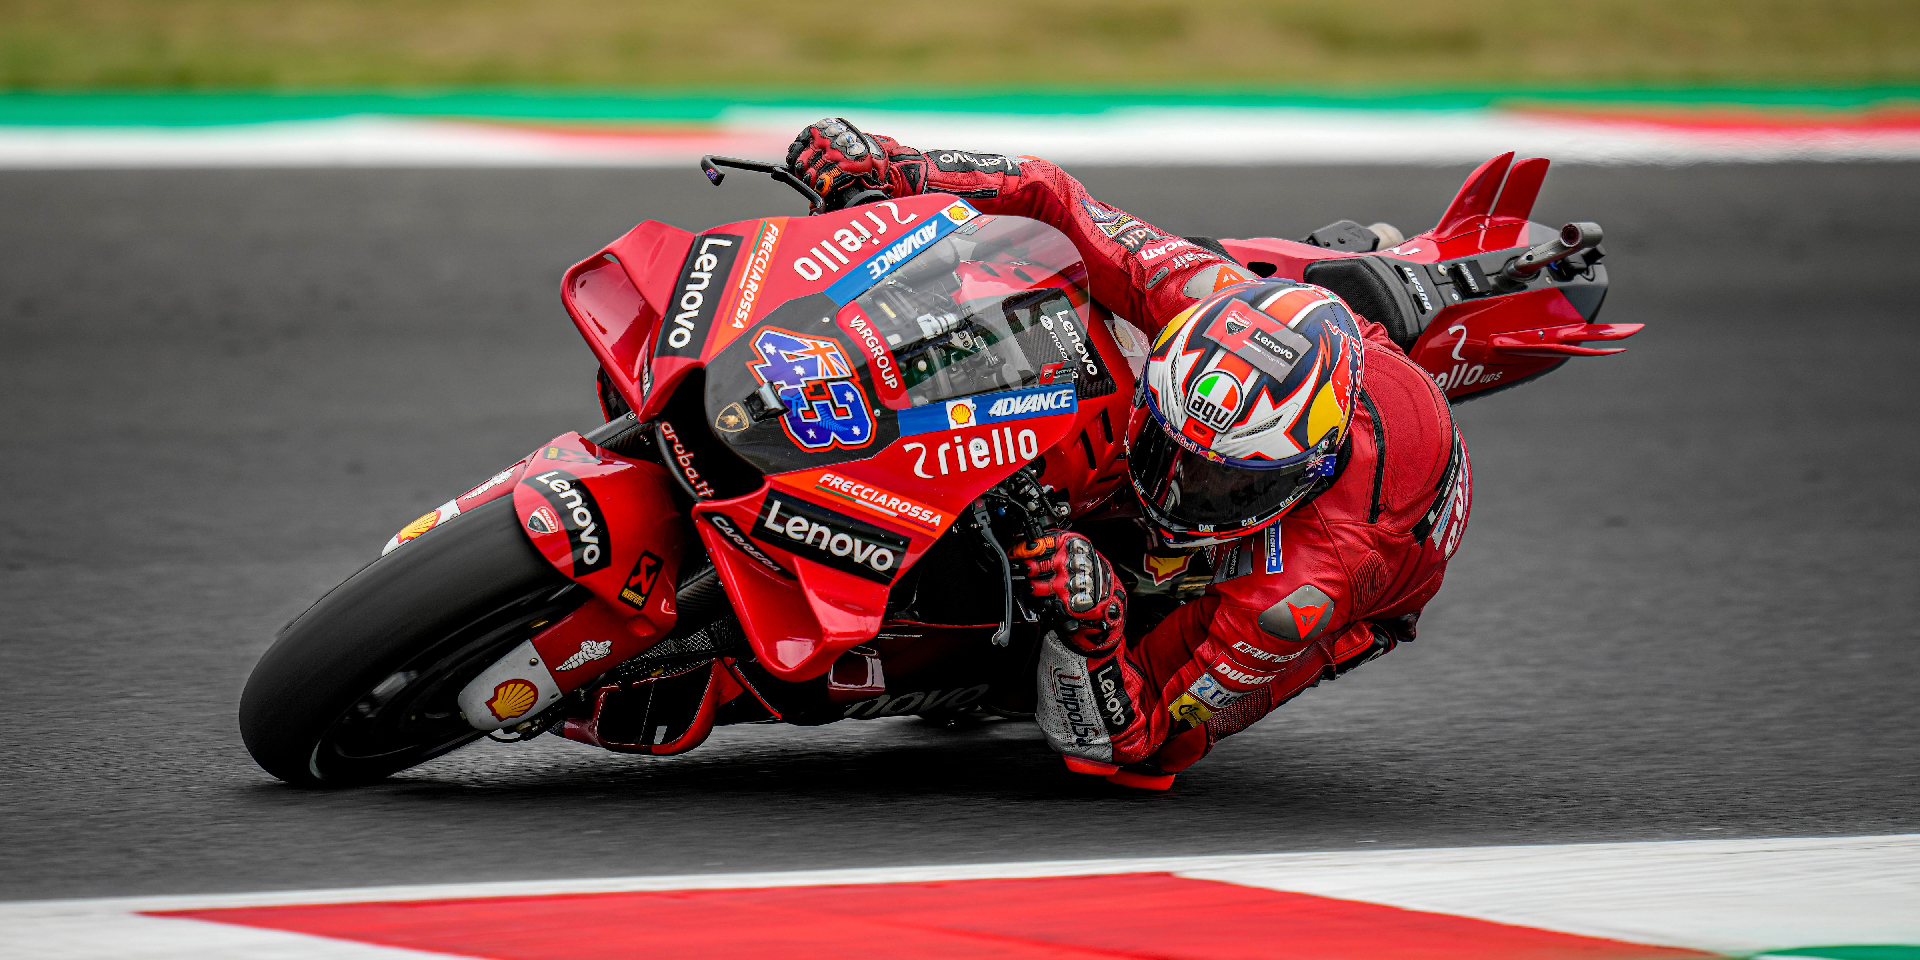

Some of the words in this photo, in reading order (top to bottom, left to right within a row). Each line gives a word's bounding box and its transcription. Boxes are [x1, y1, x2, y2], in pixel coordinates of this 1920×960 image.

[731, 223, 780, 330] FRECCIAROSSA
[866, 219, 939, 280] ADVANCE
[668, 236, 733, 349] Lenovo
[1403, 266, 1433, 311] DUCATI
[848, 314, 899, 390] VARGROUP
[1056, 309, 1098, 376] Lenovo
[1253, 331, 1294, 360] Lenovo
[747, 326, 877, 452] 43
[987, 389, 1075, 418] ADVANCE
[1191, 395, 1230, 426] agv
[659, 421, 715, 498] aruba.it
[535, 470, 601, 566] Lenovo
[540, 508, 556, 530] DUCATI
[818, 473, 942, 527] FRECCIAROSSA
[711, 515, 782, 572] CARRERA
[763, 499, 895, 572] Lenovo
[1213, 661, 1278, 685] DUCATI
